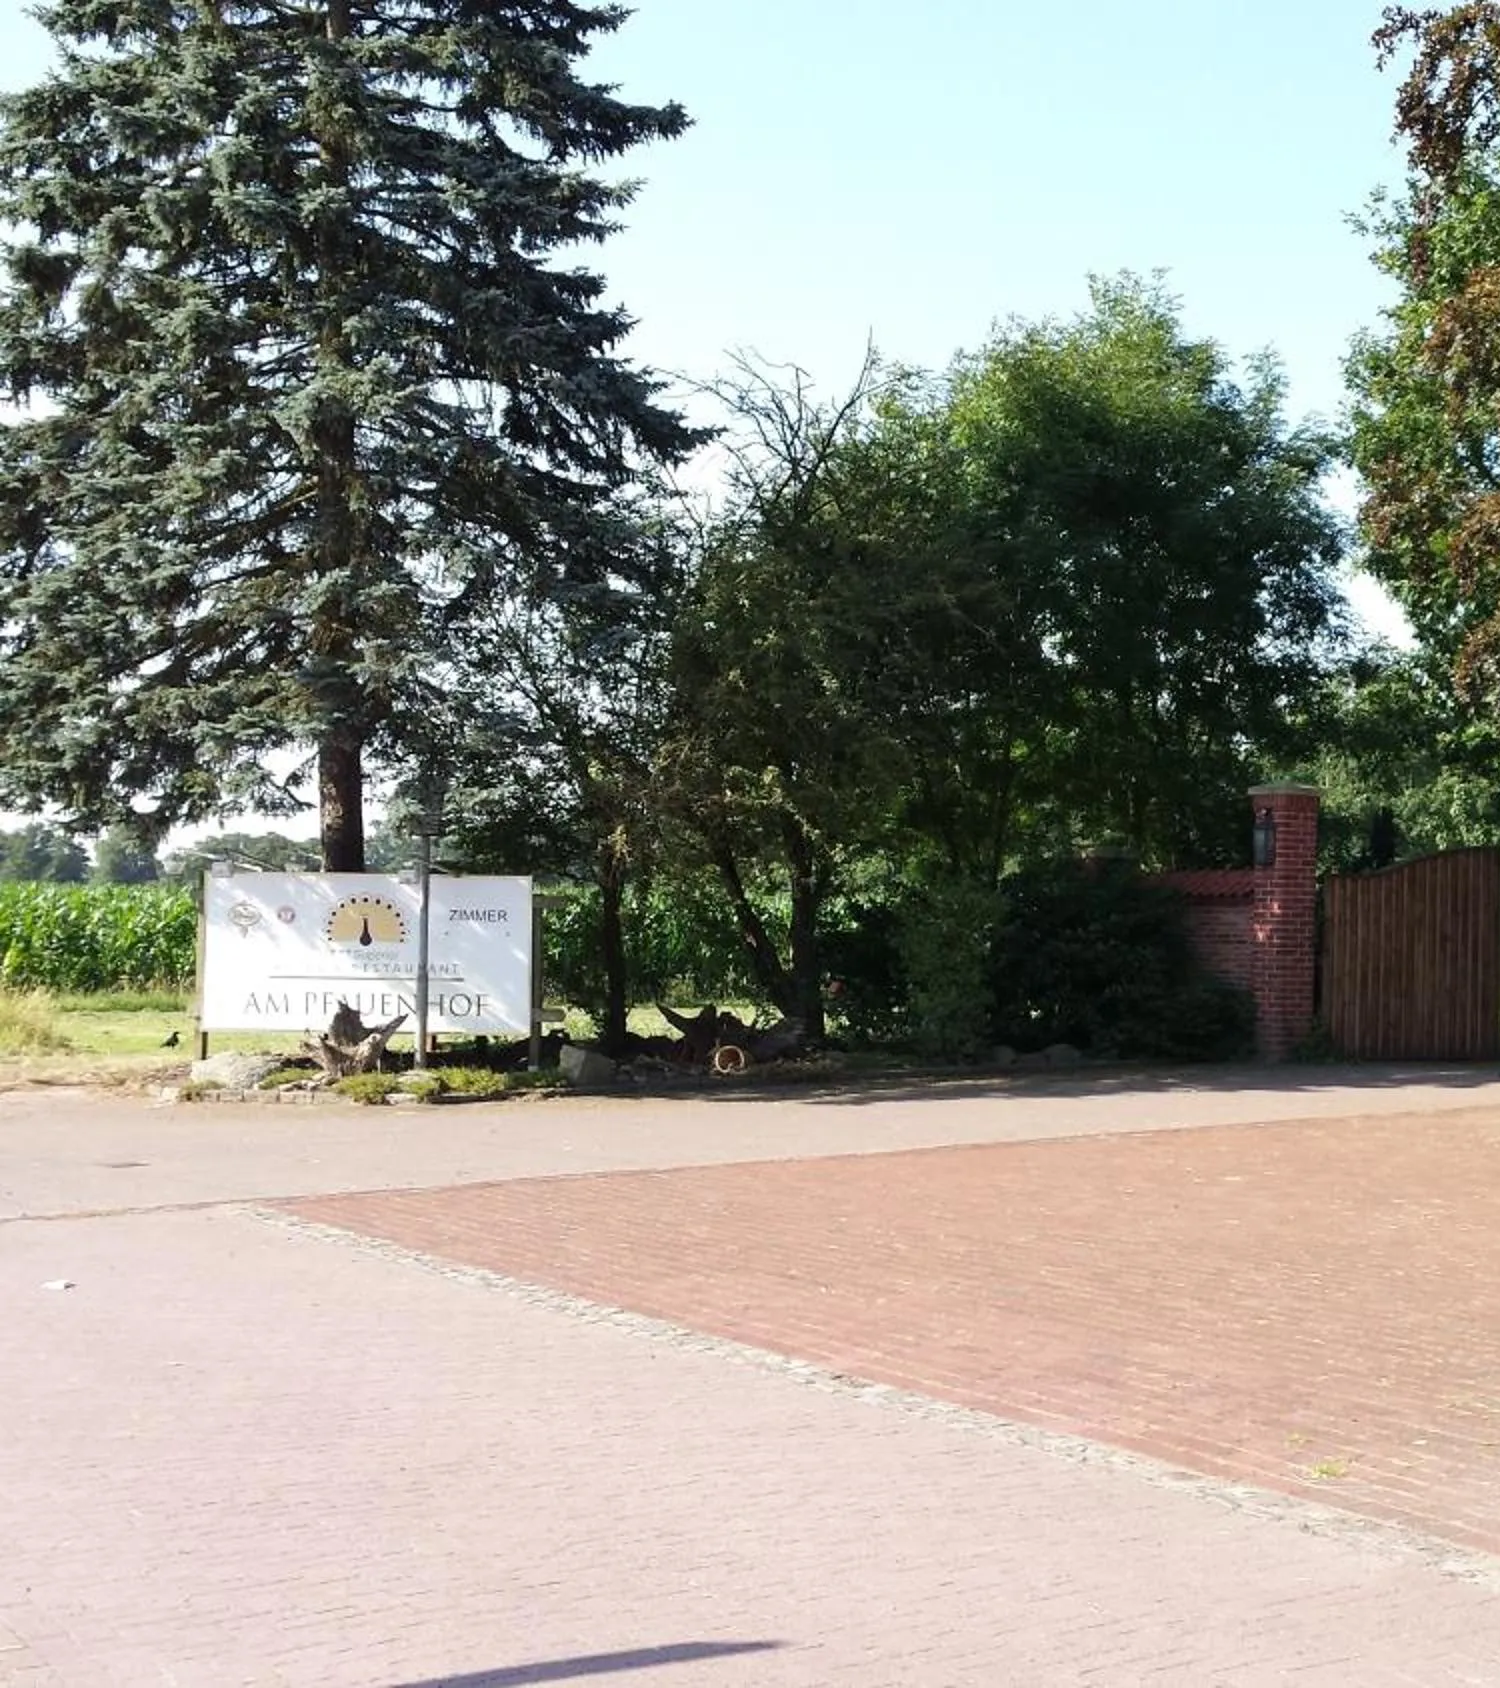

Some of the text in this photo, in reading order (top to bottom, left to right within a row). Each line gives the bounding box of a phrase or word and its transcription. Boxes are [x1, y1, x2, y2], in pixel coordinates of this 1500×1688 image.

[449, 909, 508, 922] ZIMMER
[352, 962, 460, 975] ESTAUANT
[244, 991, 289, 1015] AM
